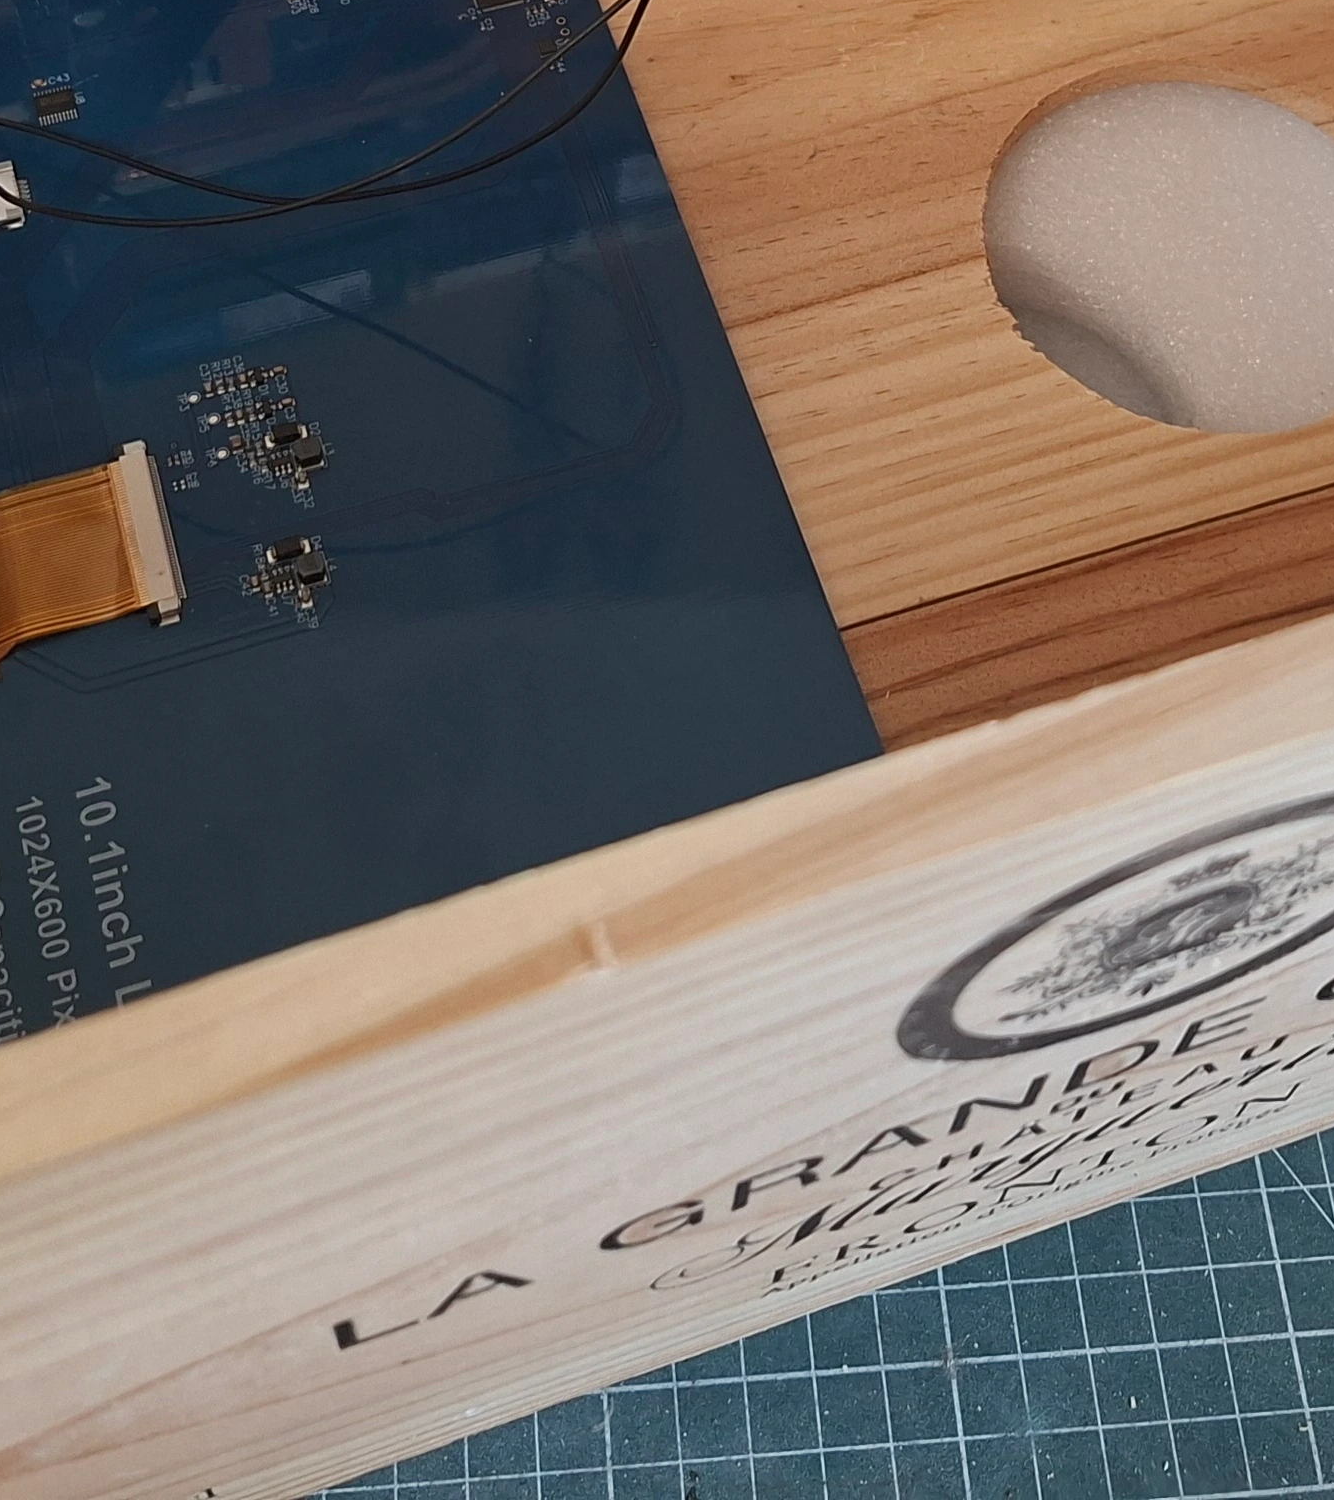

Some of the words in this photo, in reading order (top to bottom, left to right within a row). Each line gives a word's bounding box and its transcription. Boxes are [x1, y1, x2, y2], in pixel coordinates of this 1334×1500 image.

[47, 71, 71, 86] C43
[275, 373, 289, 395] C30
[175, 392, 190, 413] TP3
[195, 413, 210, 434] TP5
[237, 573, 253, 598] C42
[15, 795, 72, 961] 1024X600
[75, 775, 144, 969] 10.1inch
[1049, 1079, 1126, 1114] DU
[331, 1268, 535, 1350] LA
[599, 996, 1267, 1251] GRANDE
[765, 1075, 1311, 1285] FRONTON
[759, 1221, 963, 1299] Appellation
